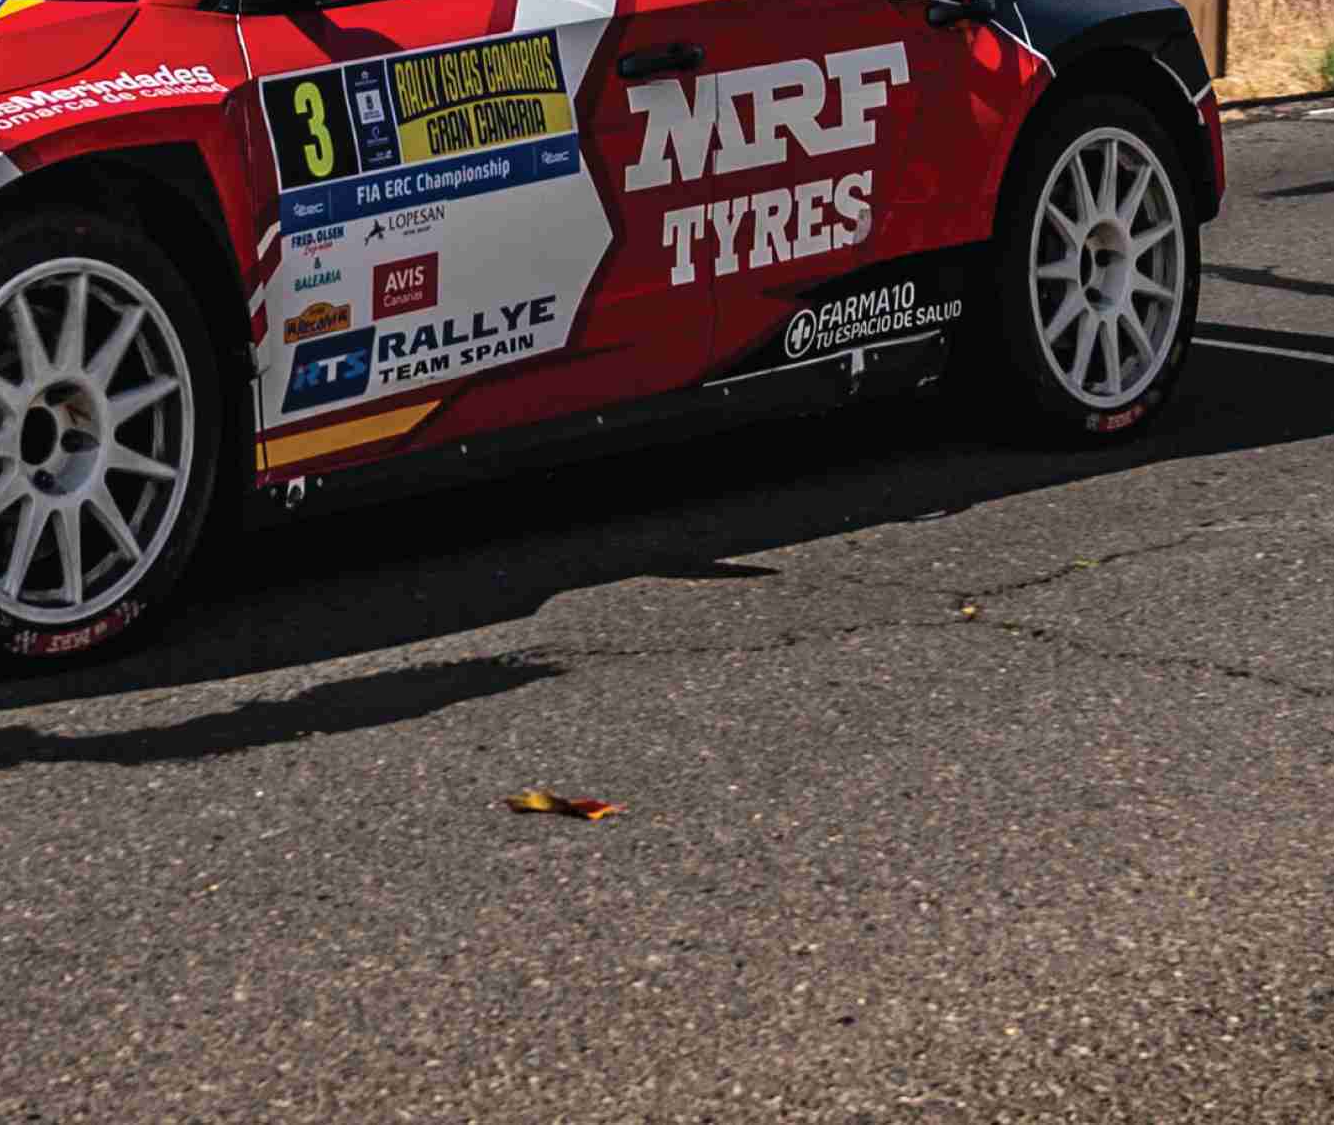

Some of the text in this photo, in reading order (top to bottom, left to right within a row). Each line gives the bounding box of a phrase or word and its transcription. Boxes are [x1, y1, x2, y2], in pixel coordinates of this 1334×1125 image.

[104, 89, 137, 105] de
[395, 35, 559, 118] RALLY ISLAS CANARIAS
[294, 82, 334, 177] 3
[427, 98, 547, 155] GRAN CANARIA
[625, 41, 909, 192] MRF
[357, 158, 511, 205] FIA ERC Championship
[388, 205, 446, 231] LOPESAN
[663, 170, 872, 286] TYRES
[383, 290, 423, 308] Canarias
[385, 267, 424, 293] AVIS
[378, 295, 556, 362] RALLYE
[817, 300, 962, 350] TU ESPACIO DE SALUD
[818, 282, 915, 331] FARMA10
[379, 333, 534, 383] TEAM SPAIN
